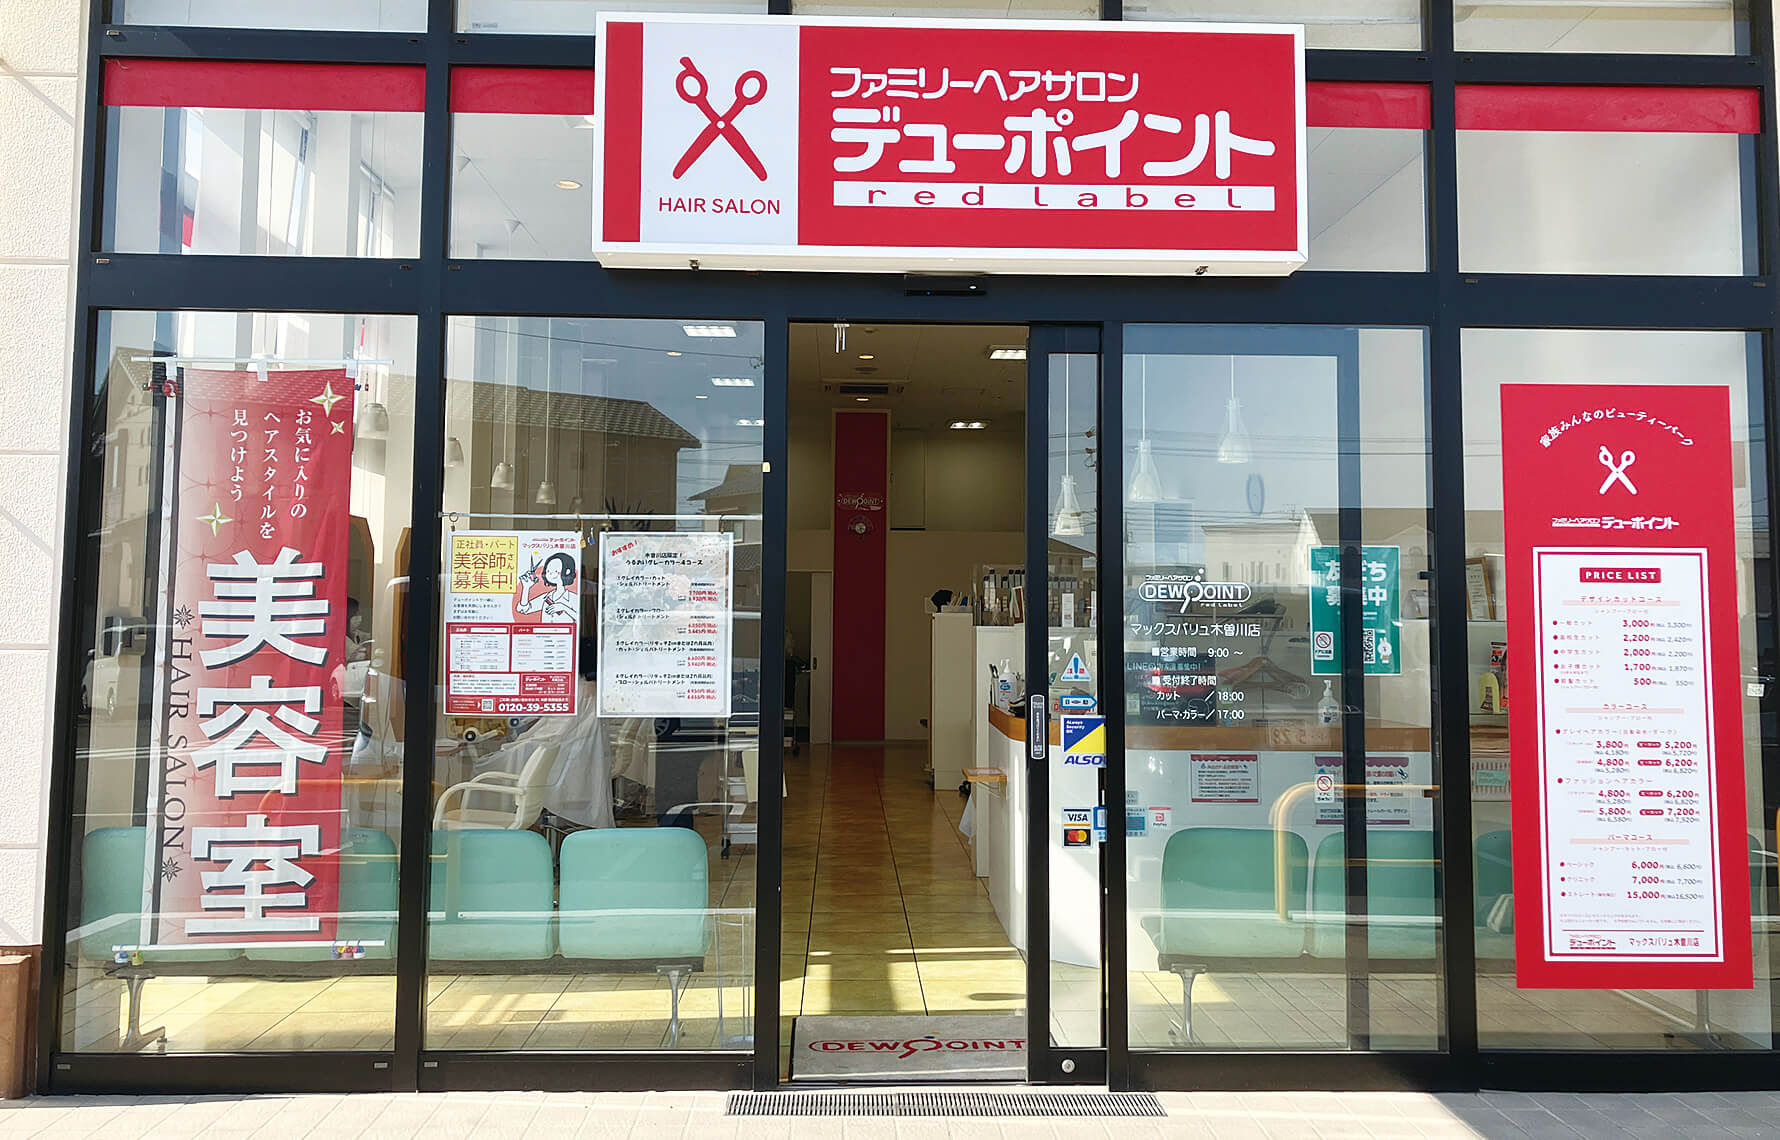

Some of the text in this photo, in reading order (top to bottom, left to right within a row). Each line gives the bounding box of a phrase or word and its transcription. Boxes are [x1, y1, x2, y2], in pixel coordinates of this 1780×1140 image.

[829, 66, 1140, 103] ファミリーヘアサロン
[830, 105, 1276, 180] デューポイント
[658, 197, 781, 215] HAIR SALON
[867, 187, 1242, 209] red label
[230, 408, 249, 503] 見つけよう
[290, 408, 313, 519] お気に入りの
[258, 411, 281, 540] ヘアスタイルを
[1601, 516, 1680, 530] デューポイント
[455, 539, 515, 550] 正社員・パート
[1585, 571, 1657, 581] PRICE LIST
[1130, 622, 1262, 638] マックスバリュ木曽川店
[1207, 647, 1230, 658] 9:00
[498, 702, 570, 712] 0120-39-5355
[161, 637, 193, 850] HAIR SALON
[185, 546, 332, 936] 美容室
[1064, 755, 1106, 765] ALSO
[1067, 813, 1089, 822] VISA
